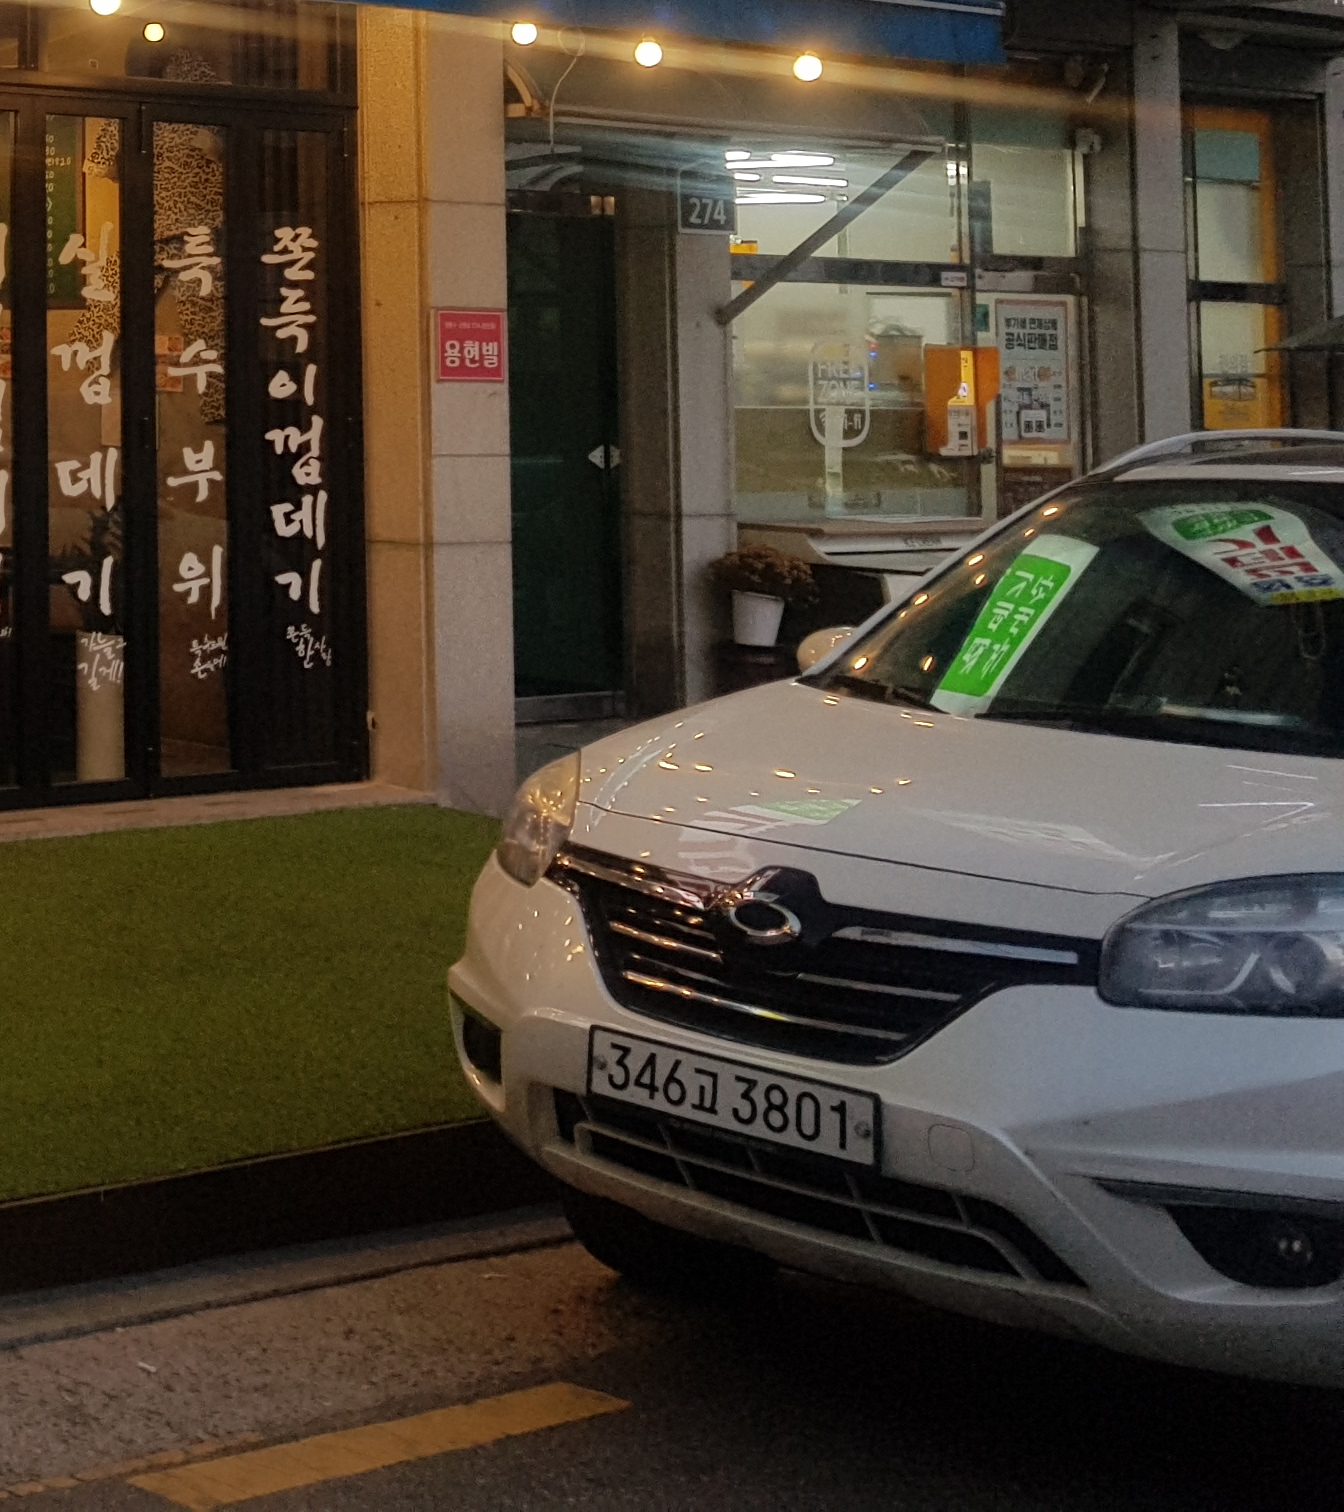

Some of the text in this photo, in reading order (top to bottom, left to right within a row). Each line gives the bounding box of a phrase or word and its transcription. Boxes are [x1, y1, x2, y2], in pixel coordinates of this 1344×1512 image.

[689, 197, 727, 225] 274
[444, 340, 499, 368] 용현빌
[607, 1042, 848, 1151] 346고 3801
